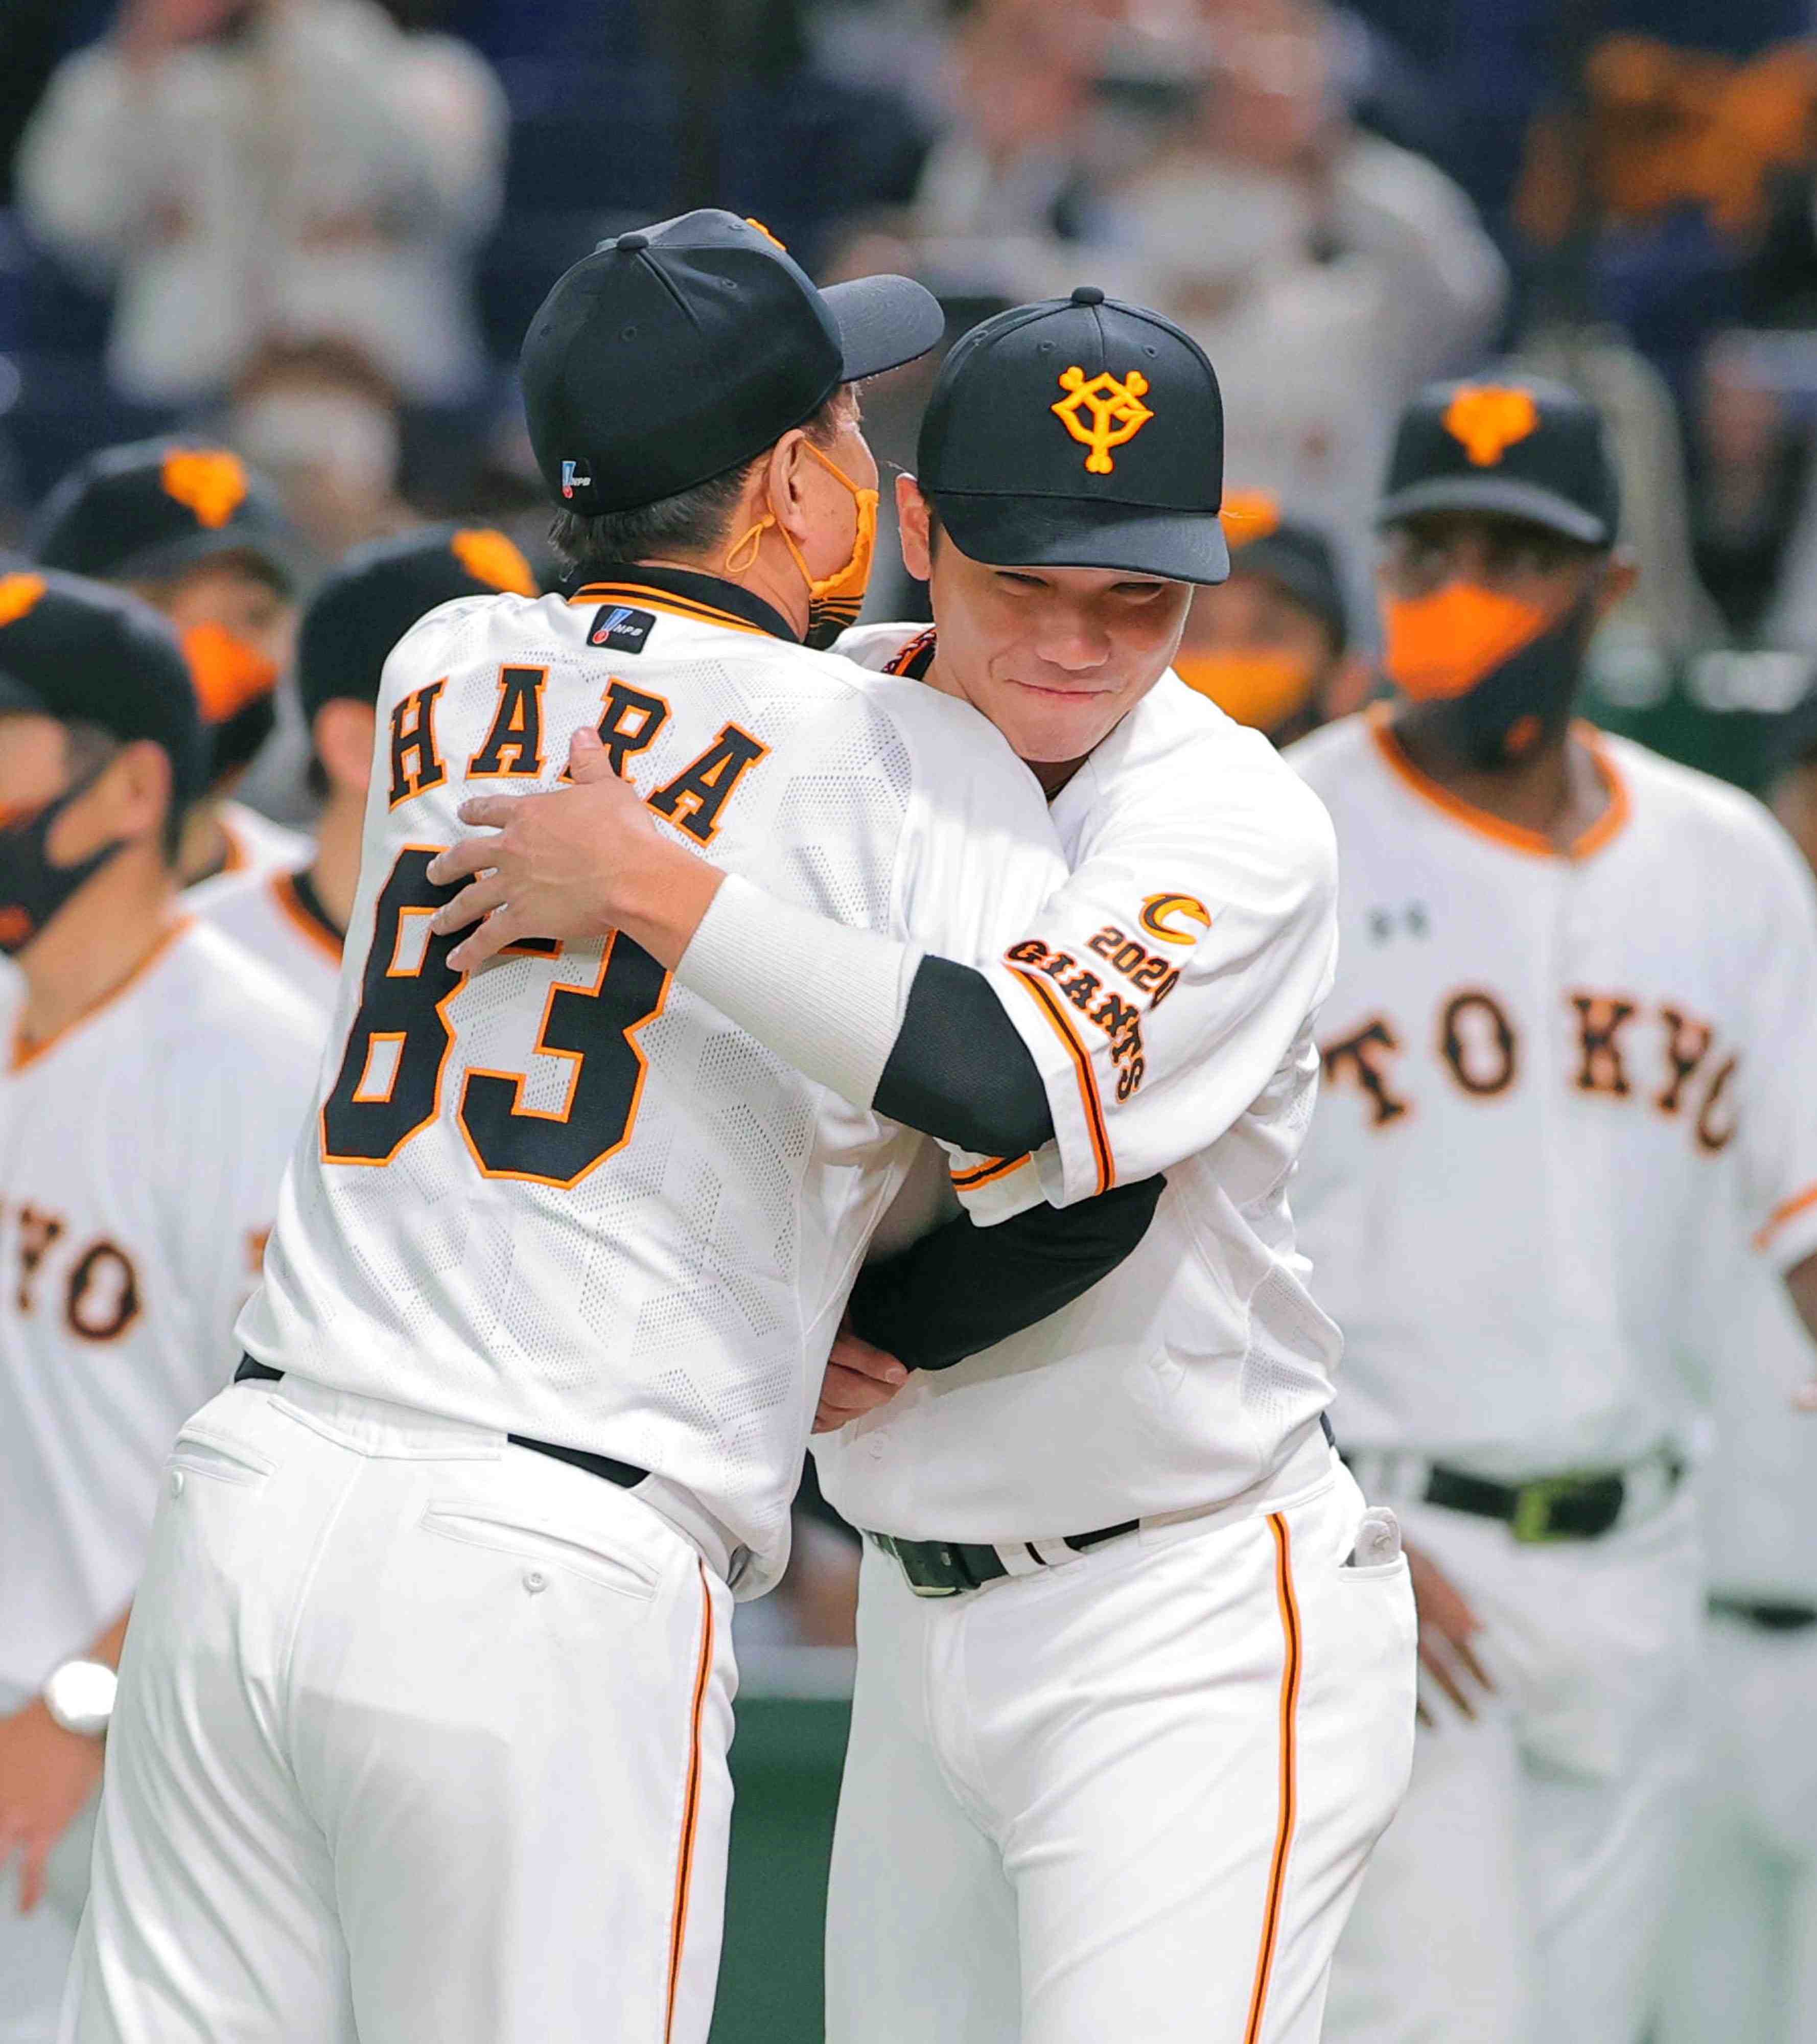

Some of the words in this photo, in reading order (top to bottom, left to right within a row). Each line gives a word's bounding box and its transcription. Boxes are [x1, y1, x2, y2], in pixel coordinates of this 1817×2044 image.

[613, 624, 643, 636] NPB
[388, 663, 773, 848] HARA
[319, 843, 673, 1191] 83
[1004, 939, 1146, 1104] GIANTS
[1086, 925, 1181, 1010] 2020
